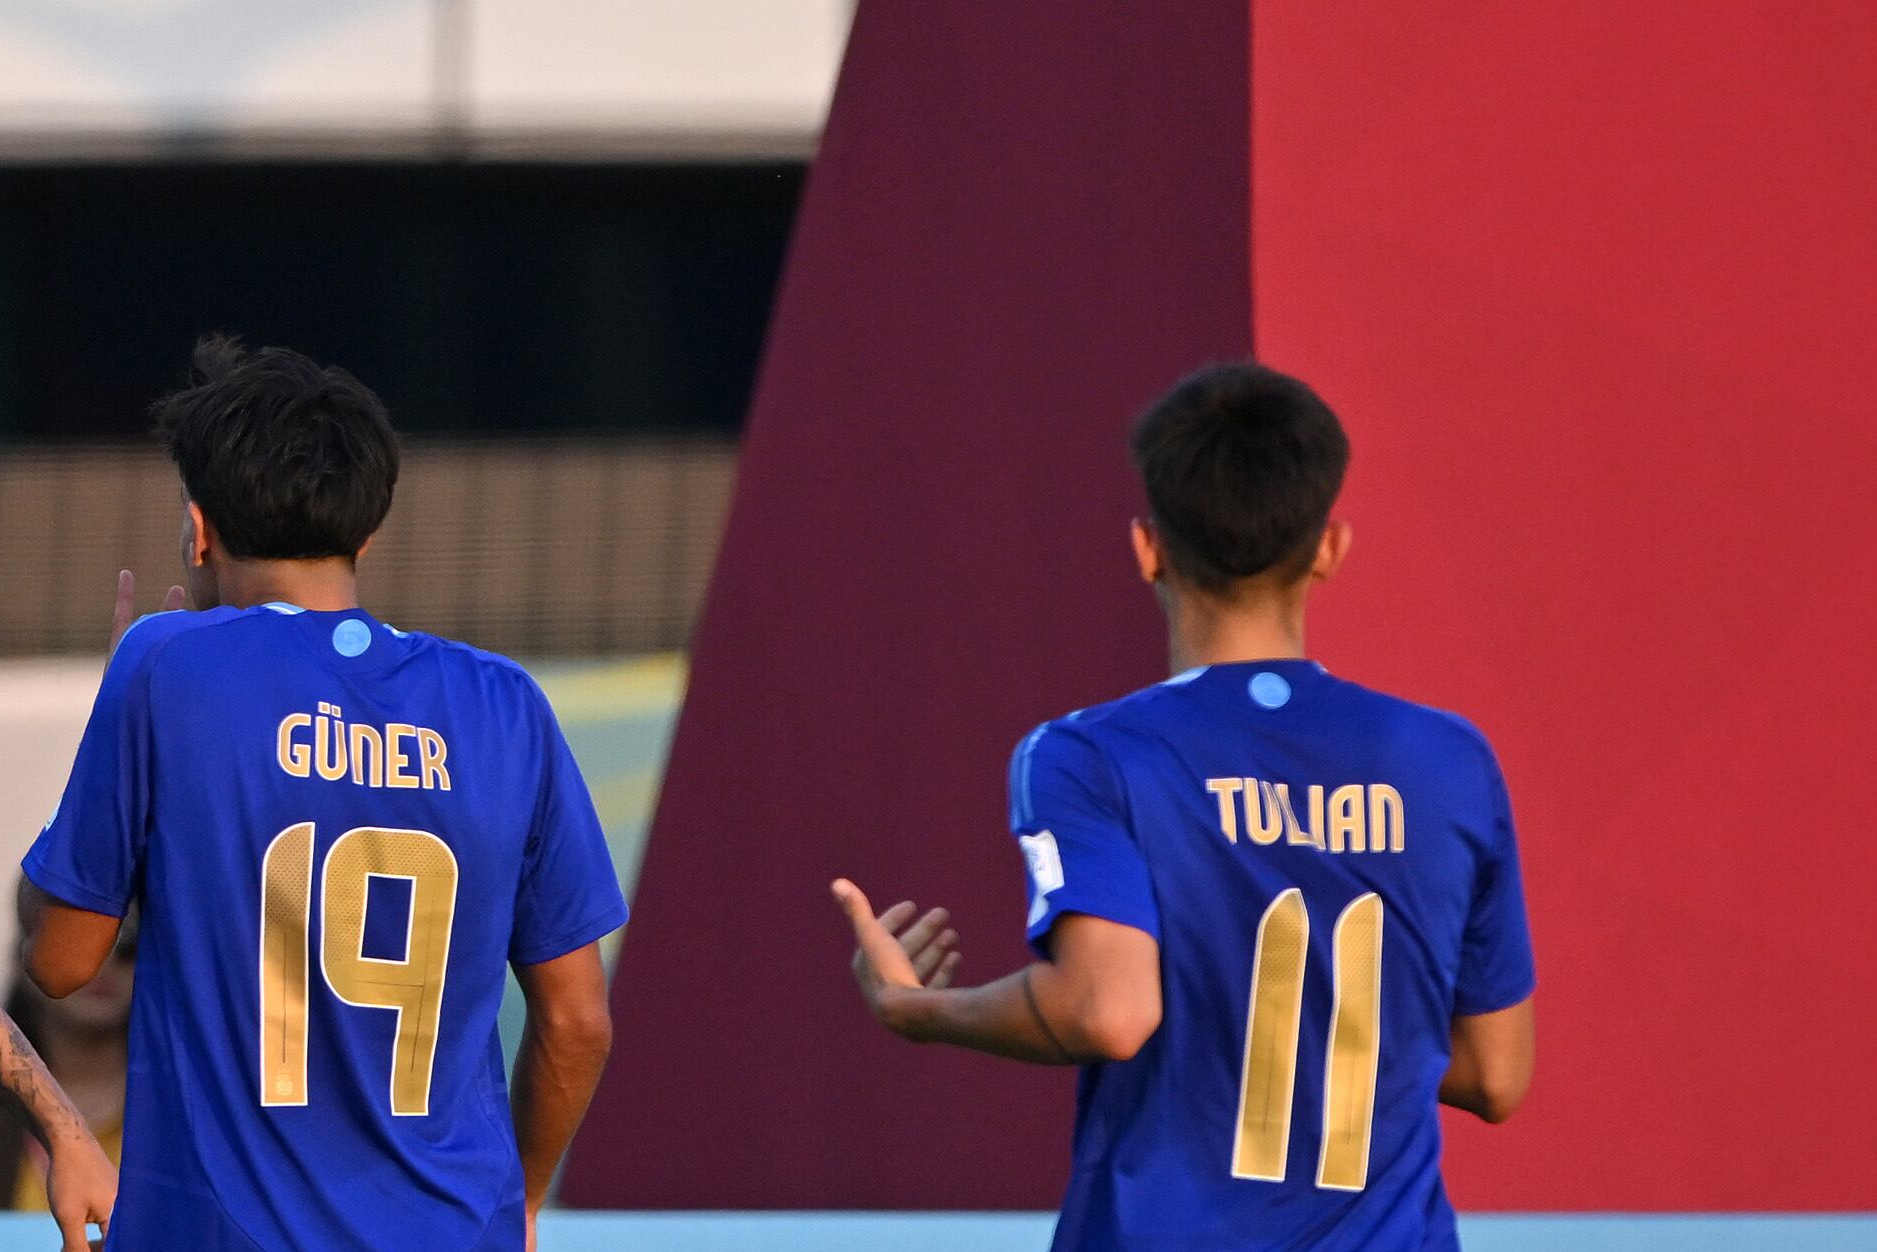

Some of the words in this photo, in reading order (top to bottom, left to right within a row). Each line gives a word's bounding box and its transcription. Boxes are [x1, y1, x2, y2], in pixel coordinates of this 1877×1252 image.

[277, 701, 452, 791] GÜNER
[1206, 776, 1405, 853] TULIAN
[260, 821, 460, 1117] 19
[1231, 887, 1384, 1192] 11
